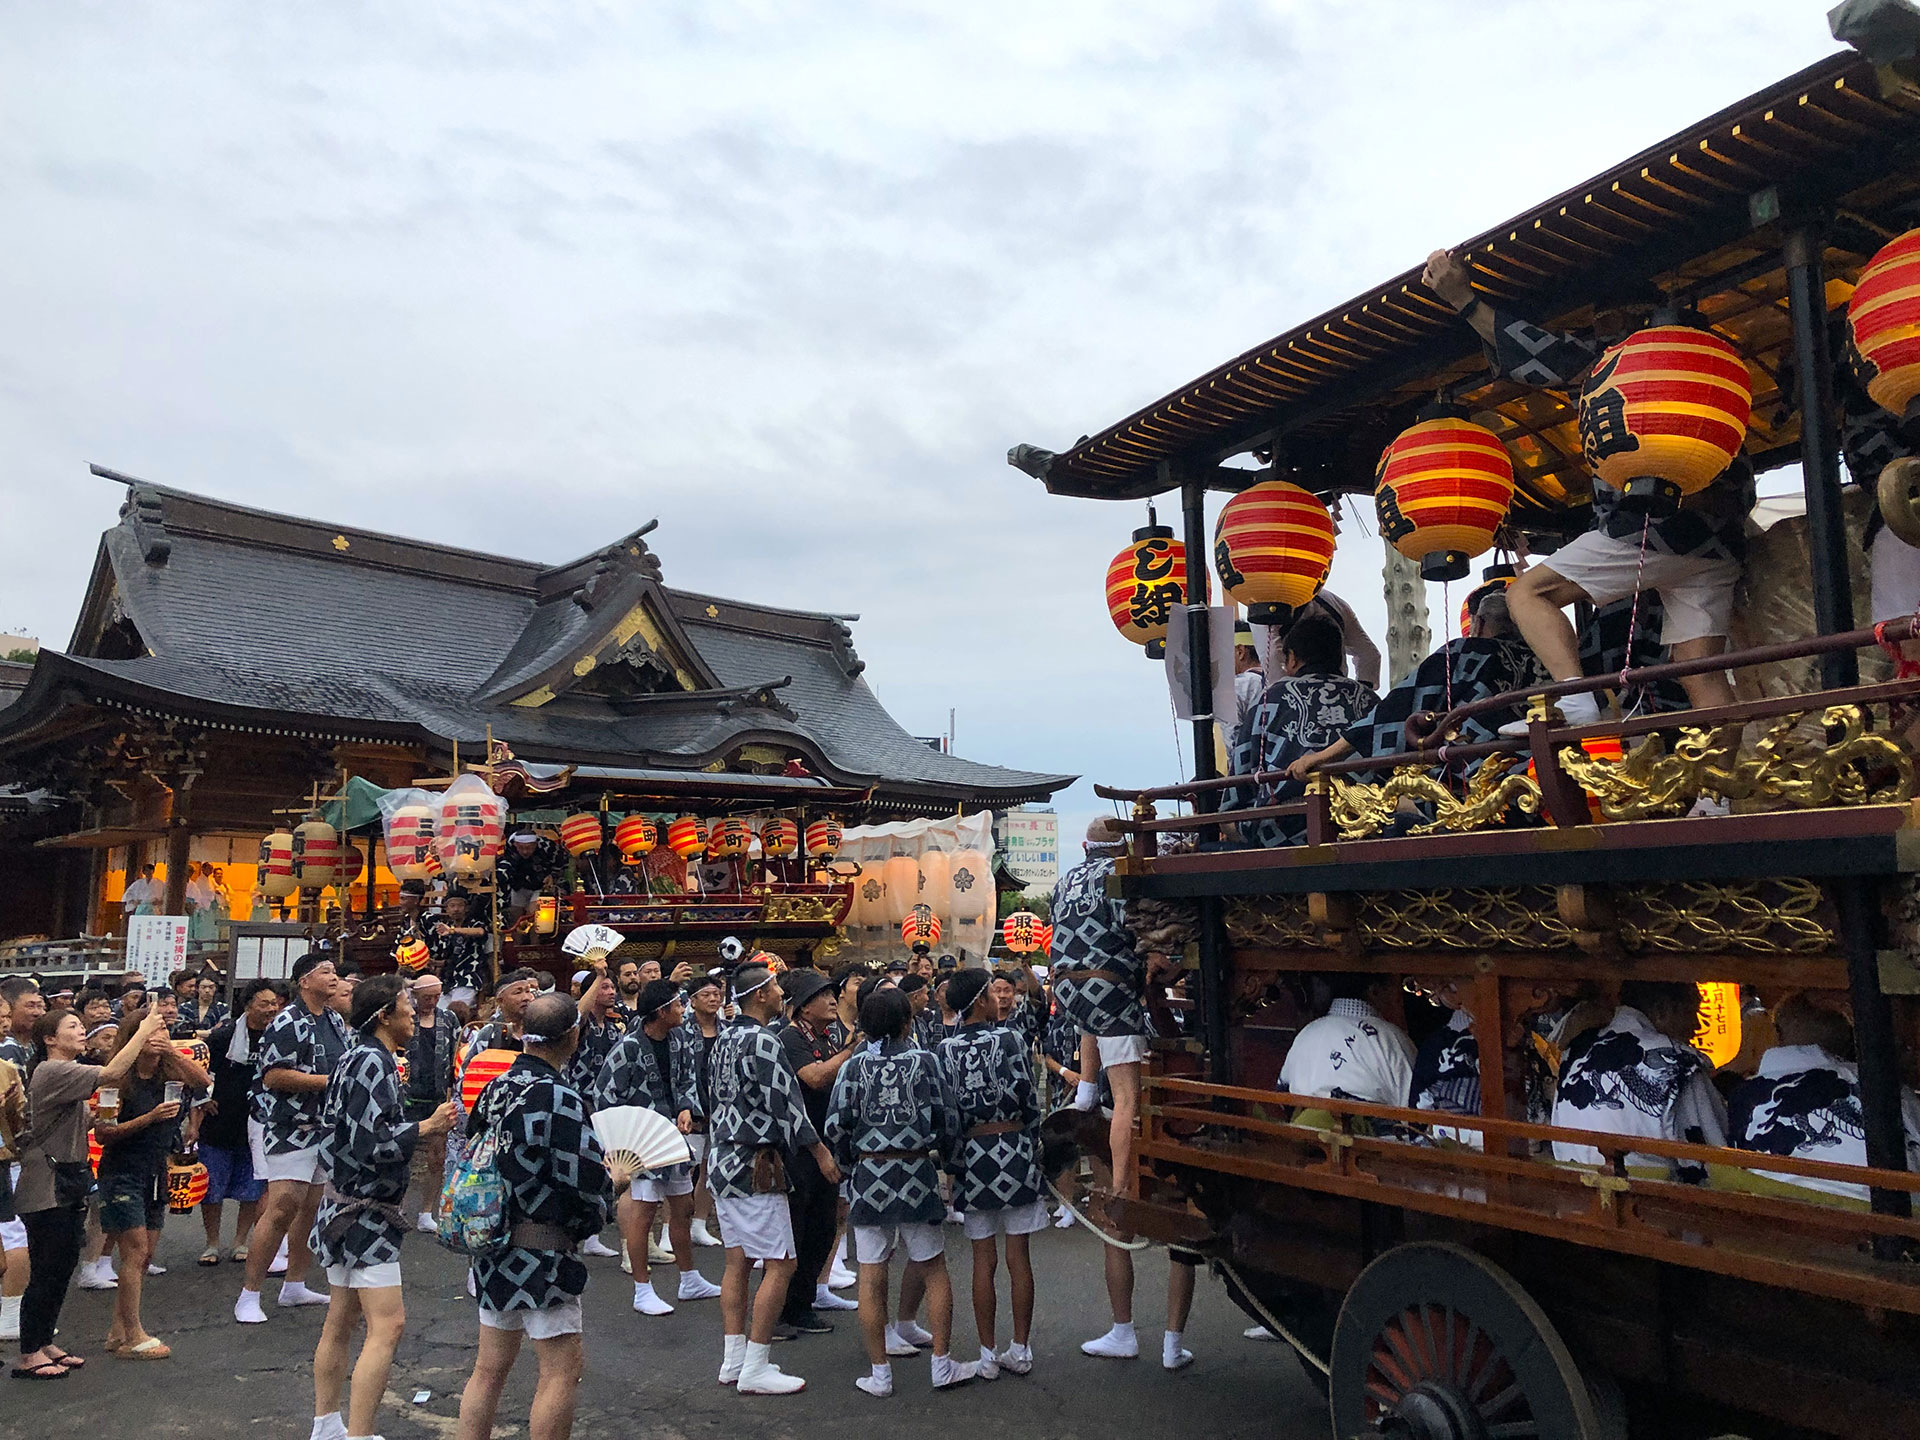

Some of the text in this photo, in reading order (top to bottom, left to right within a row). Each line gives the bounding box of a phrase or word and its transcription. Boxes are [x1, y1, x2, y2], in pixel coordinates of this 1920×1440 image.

[455, 805, 485, 861] 三町
[723, 816, 745, 848] 三町
[764, 818, 784, 848] 三町
[826, 819, 842, 849] 三町
[1035, 837, 1055, 847] プラザ
[1016, 852, 1056, 863] いしい眼科
[1013, 915, 1033, 947] 取締
